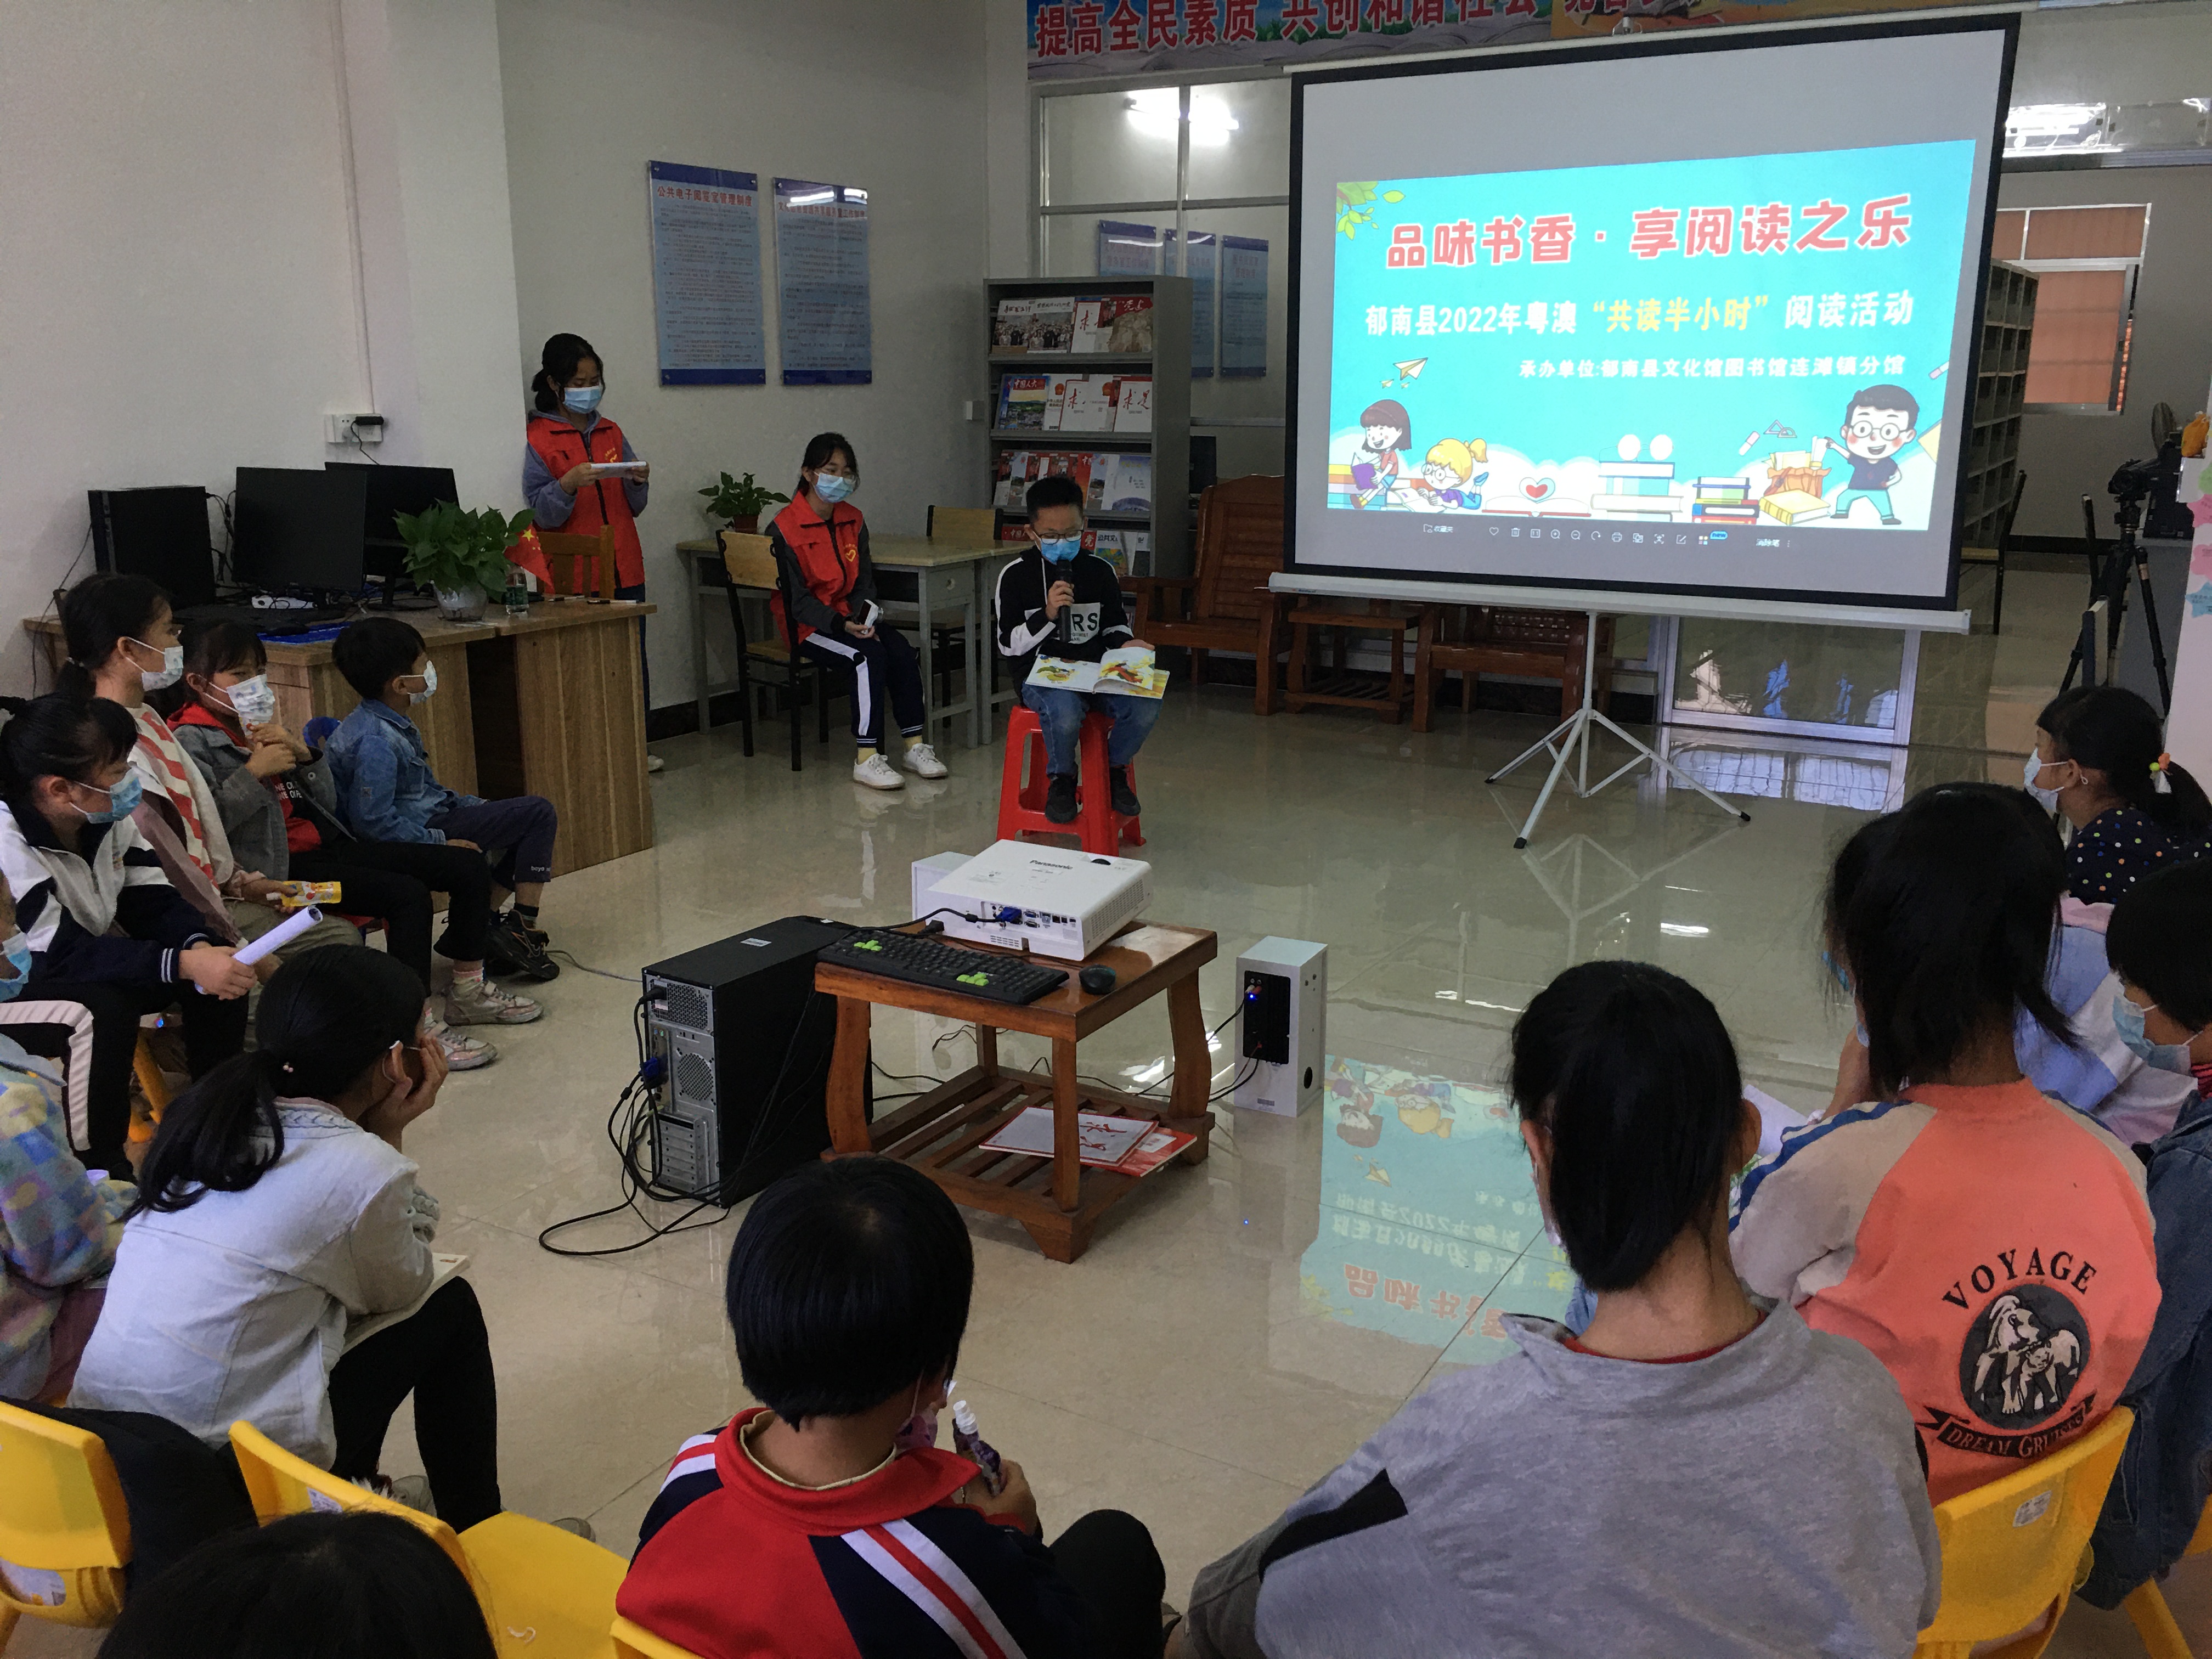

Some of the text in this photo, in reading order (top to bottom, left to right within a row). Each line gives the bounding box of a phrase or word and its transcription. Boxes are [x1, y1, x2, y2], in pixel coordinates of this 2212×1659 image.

[1036, 0, 1257, 57] 提高全民素质
[658, 186, 752, 206] 公共电子阅览室管理制度
[1123, 388, 1150, 409] 求是
[1030, 860, 1073, 870] Panasonic
[1942, 1248, 2097, 1310] VOYAGE
[1947, 1427, 2012, 1455] DREAM
